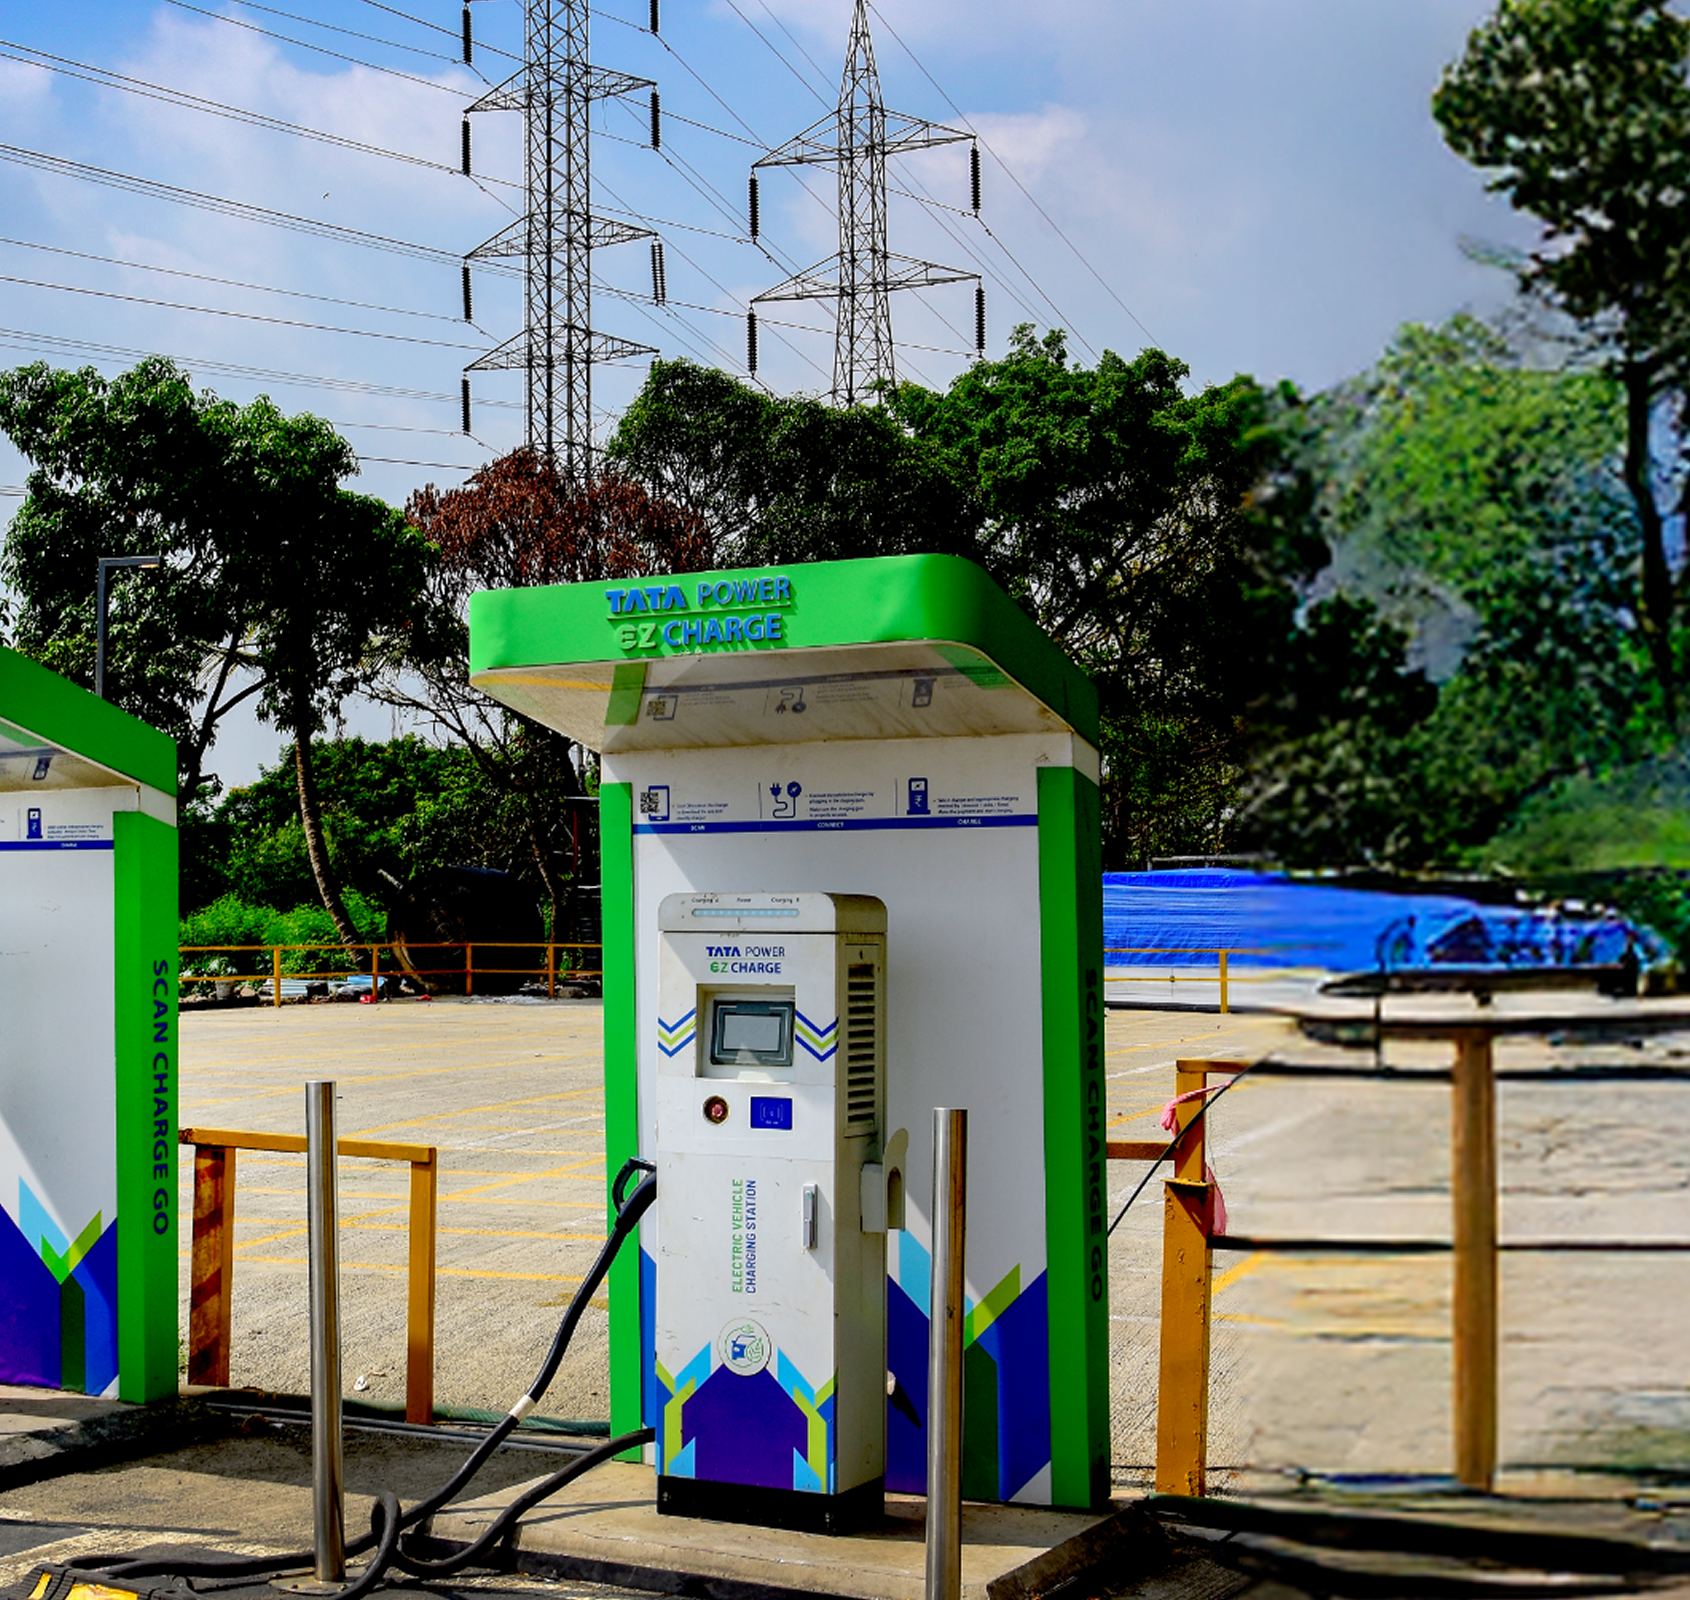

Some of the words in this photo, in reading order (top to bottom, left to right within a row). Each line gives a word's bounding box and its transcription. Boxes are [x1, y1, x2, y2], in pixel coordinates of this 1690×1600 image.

[605, 585, 687, 613] TATA
[697, 576, 791, 606] POWER
[663, 613, 782, 647] CHARGE
[706, 946, 741, 957] TATA
[745, 946, 785, 957] POWER
[731, 962, 782, 973] CHARGE
[153, 960, 169, 1042] SCAN
[1085, 968, 1099, 1071] SCAN
[153, 1052, 169, 1180] CHARGE
[1087, 1079, 1102, 1237] CHARGE
[153, 1188, 169, 1235] GO
[732, 1179, 743, 1231] VEHICLE
[745, 1180, 757, 1231] STATION
[732, 1234, 743, 1293] ELECTRIC
[745, 1233, 757, 1294] CHARGING
[1090, 1244, 1103, 1303] GO
